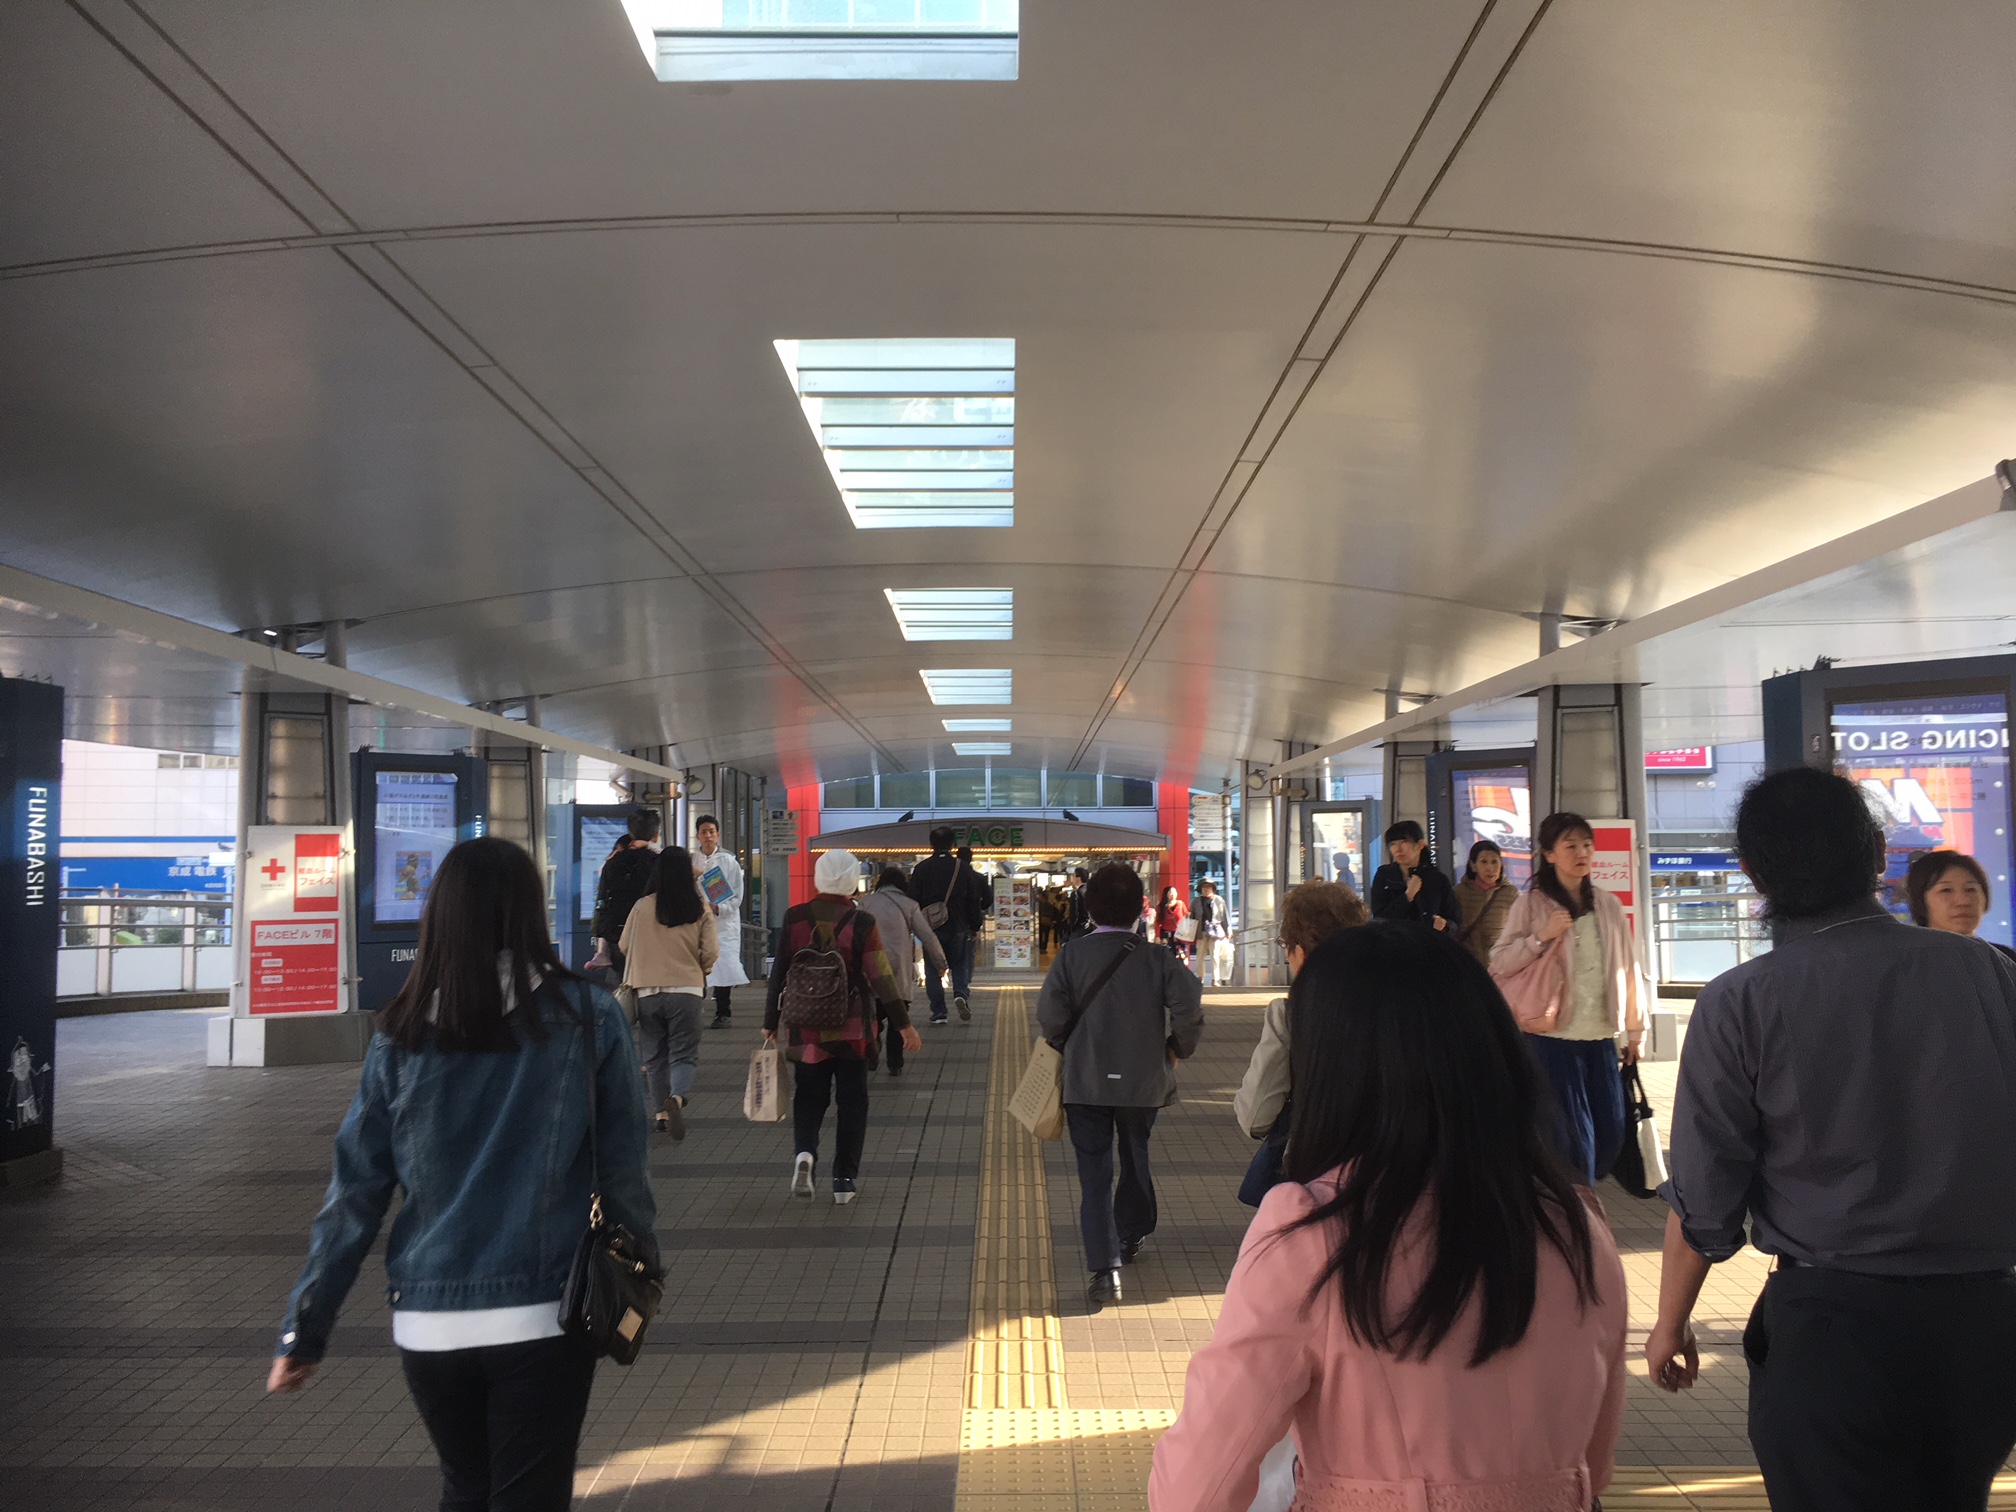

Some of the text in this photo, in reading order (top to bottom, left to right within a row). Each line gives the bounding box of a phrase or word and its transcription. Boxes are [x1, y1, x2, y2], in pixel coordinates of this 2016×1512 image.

[952, 827, 1024, 847] FACE
[1429, 810, 1438, 867] FUNABAS
[26, 786, 48, 906] FUNABASHI
[1656, 856, 1693, 865] みずほ銀行
[299, 876, 335, 886] フェイス
[1592, 870, 1629, 880] フェイス
[257, 928, 333, 940] FACEビル 7階
